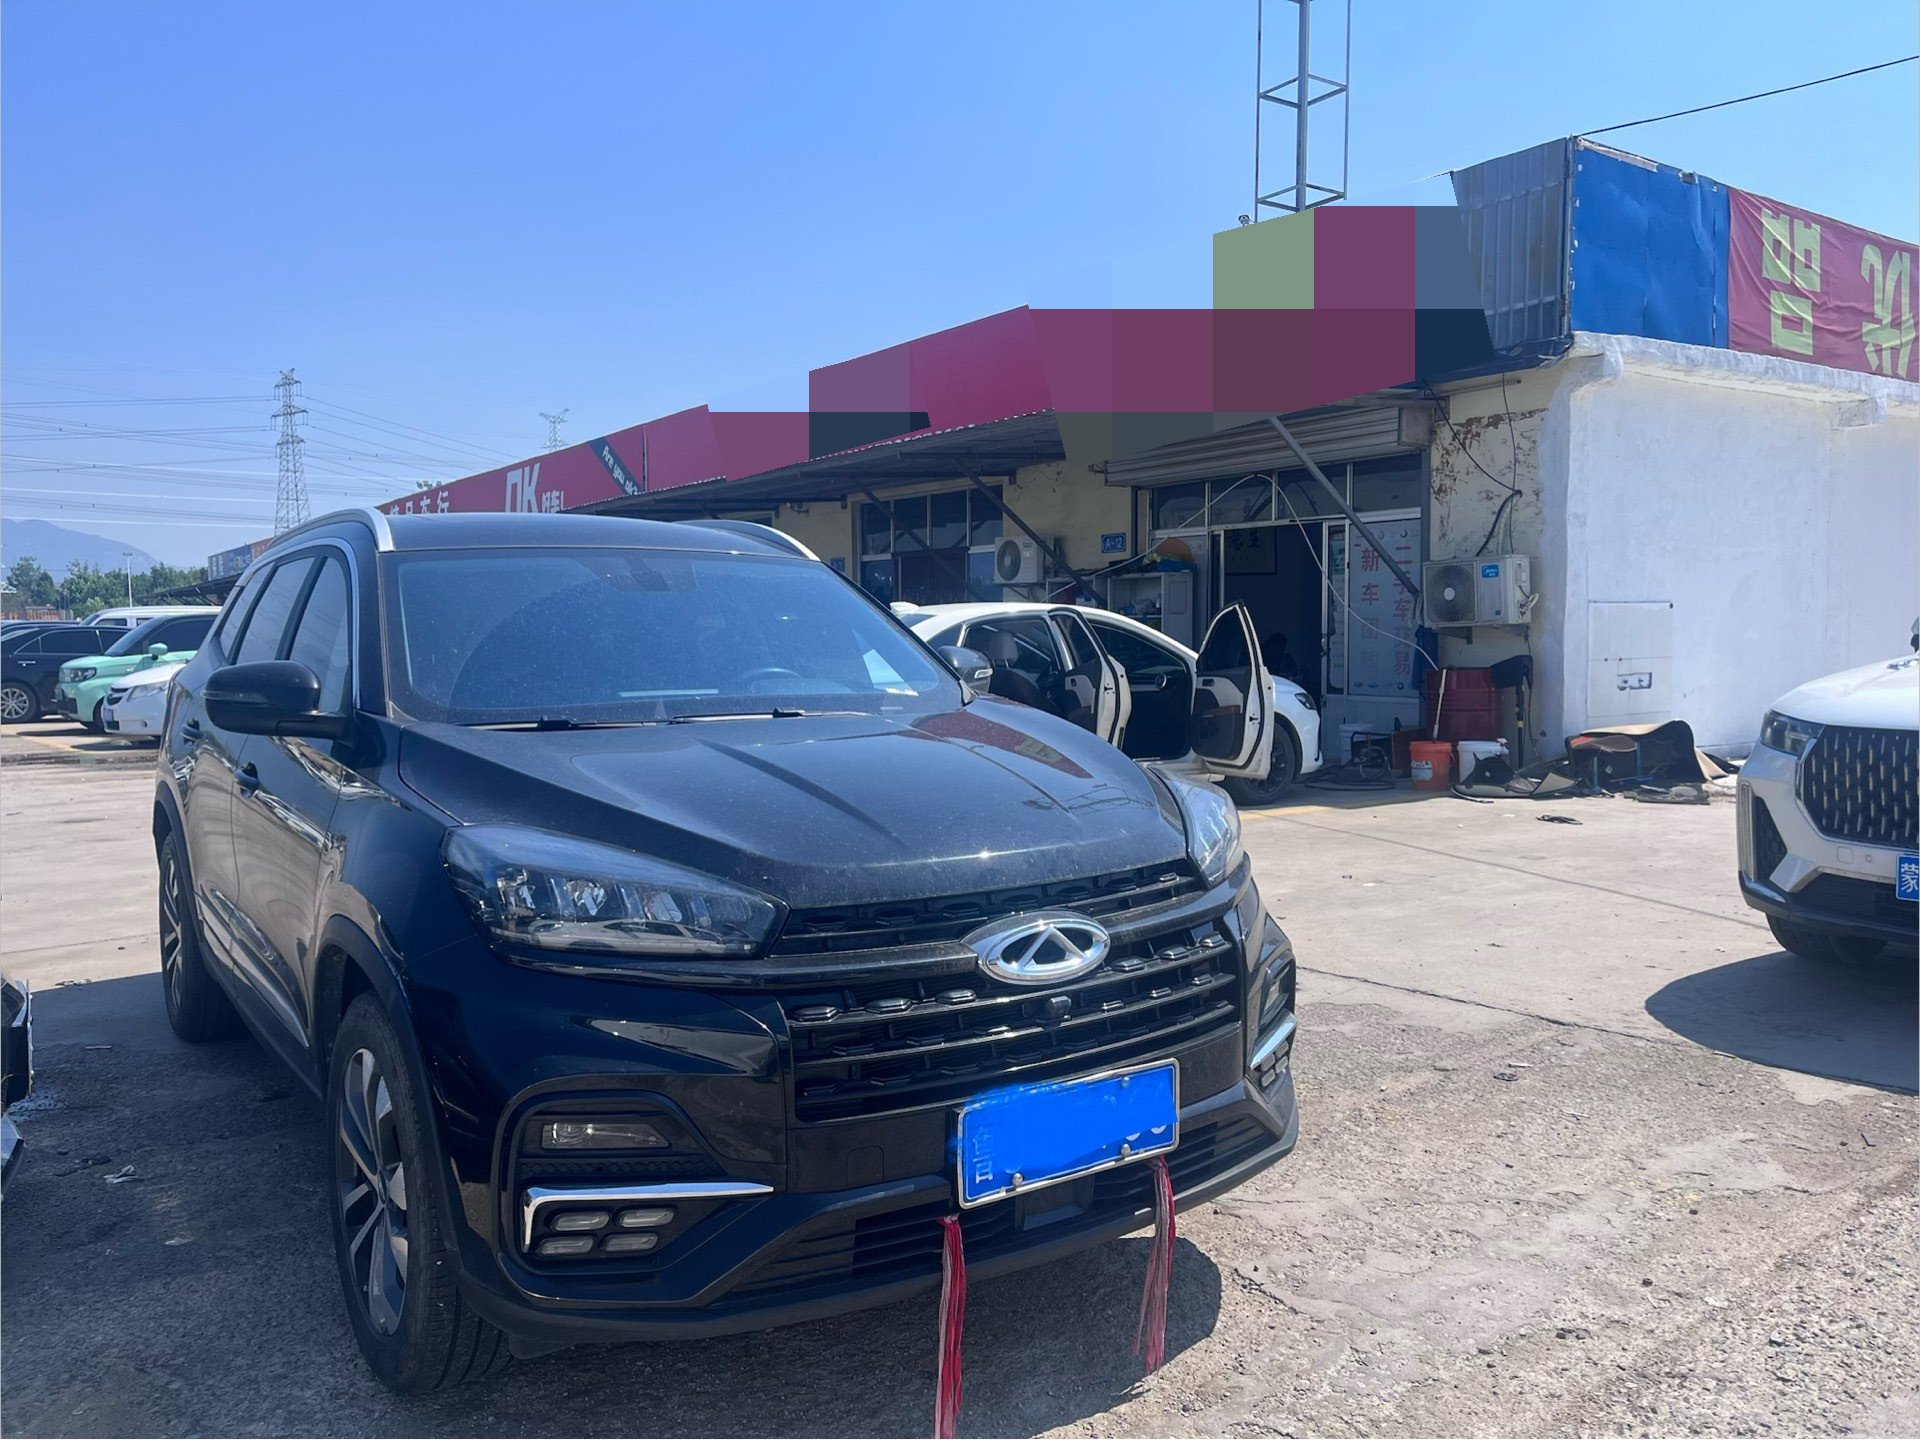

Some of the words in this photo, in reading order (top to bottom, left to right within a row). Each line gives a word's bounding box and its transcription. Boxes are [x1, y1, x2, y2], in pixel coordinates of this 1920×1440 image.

[1761, 206, 1916, 378] 优品
[505, 463, 540, 513] OK
[1105, 536, 1123, 549] A-12
[1900, 863, 1919, 893] 蒙
